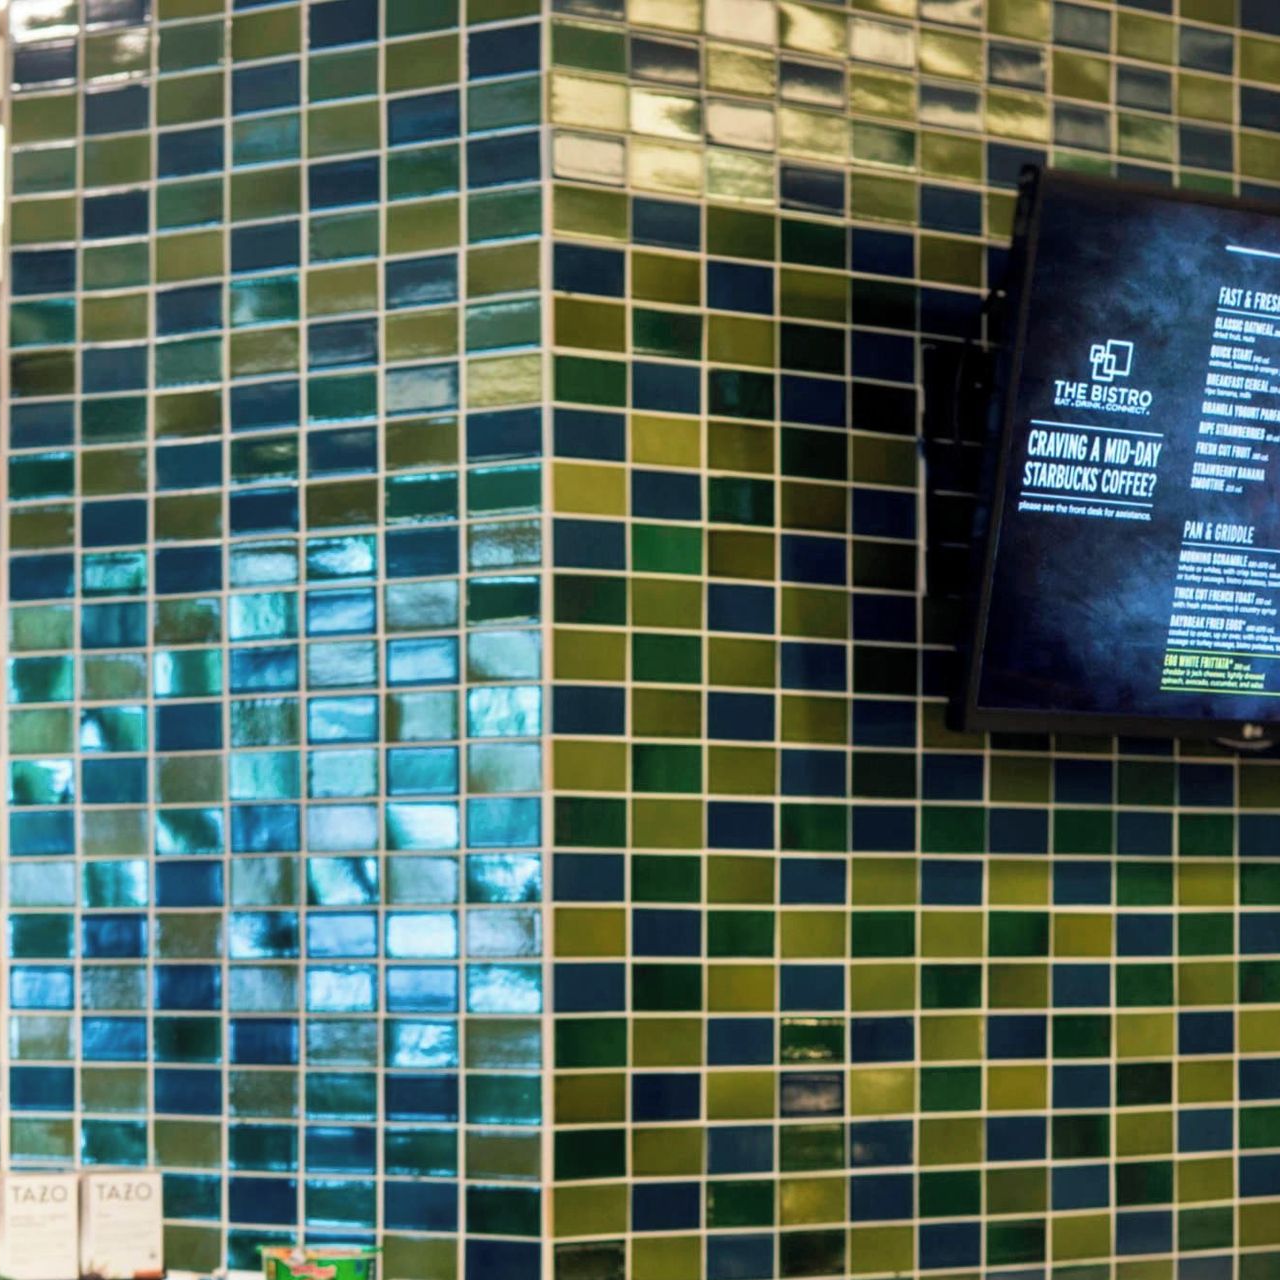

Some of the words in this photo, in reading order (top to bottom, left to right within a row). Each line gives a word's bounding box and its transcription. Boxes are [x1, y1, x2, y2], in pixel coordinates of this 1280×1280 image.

[1219, 287, 1243, 306] FAST
[1244, 291, 1252, 308] &
[1215, 317, 1243, 332] CLASSIC
[1244, 321, 1274, 336] OATMEAL
[1211, 345, 1232, 359] QUICK
[1232, 348, 1253, 361] START
[1206, 373, 1244, 389] BREAKFAST
[1244, 378, 1269, 392] CEREAL
[1055, 380, 1088, 401] THE
[1091, 385, 1152, 407] BISTRO
[1202, 401, 1233, 416] GRANOLA
[1234, 405, 1260, 419] YOGURT
[1199, 421, 1215, 435] RIPE
[1215, 423, 1265, 440] STRAWBERRIES
[1028, 430, 1088, 460] CRAVING
[1090, 437, 1100, 462] A
[1104, 438, 1162, 467] MID-DAY
[1196, 442, 1217, 455] FRESH
[1218, 444, 1231, 456] CUT
[1232, 445, 1251, 459] FRUIT
[1193, 462, 1237, 478] STRAWBERRY
[1237, 467, 1264, 481] BANANA
[1102, 469, 1157, 497] COFFEE?
[1191, 476, 1225, 491] SMOOTHIE
[1019, 501, 1042, 510] please
[1043, 504, 1055, 512] see
[1056, 504, 1068, 513] the
[1069, 505, 1086, 514] front
[1087, 507, 1103, 516] desk
[1104, 508, 1114, 517] for
[1115, 511, 1151, 520] assistance.
[1184, 521, 1204, 539] PAN
[1205, 523, 1212, 540] &
[1215, 523, 1254, 544] GRIDDLE
[1180, 550, 1211, 564] MORNING
[1213, 553, 1248, 567] SCRAMBLE
[1175, 587, 1194, 600] THICK
[1195, 588, 1208, 601] CUT
[1208, 590, 1234, 602] FRENCH
[1235, 592, 1255, 604] TOAST
[1170, 614, 1205, 628] DAYBREAK
[1205, 617, 1224, 630] FRIED
[1164, 654, 1178, 666] EGG
[1179, 656, 1199, 667] WHITE
[12, 1184, 68, 1203] TAZO
[96, 1182, 153, 1201] TAZO
